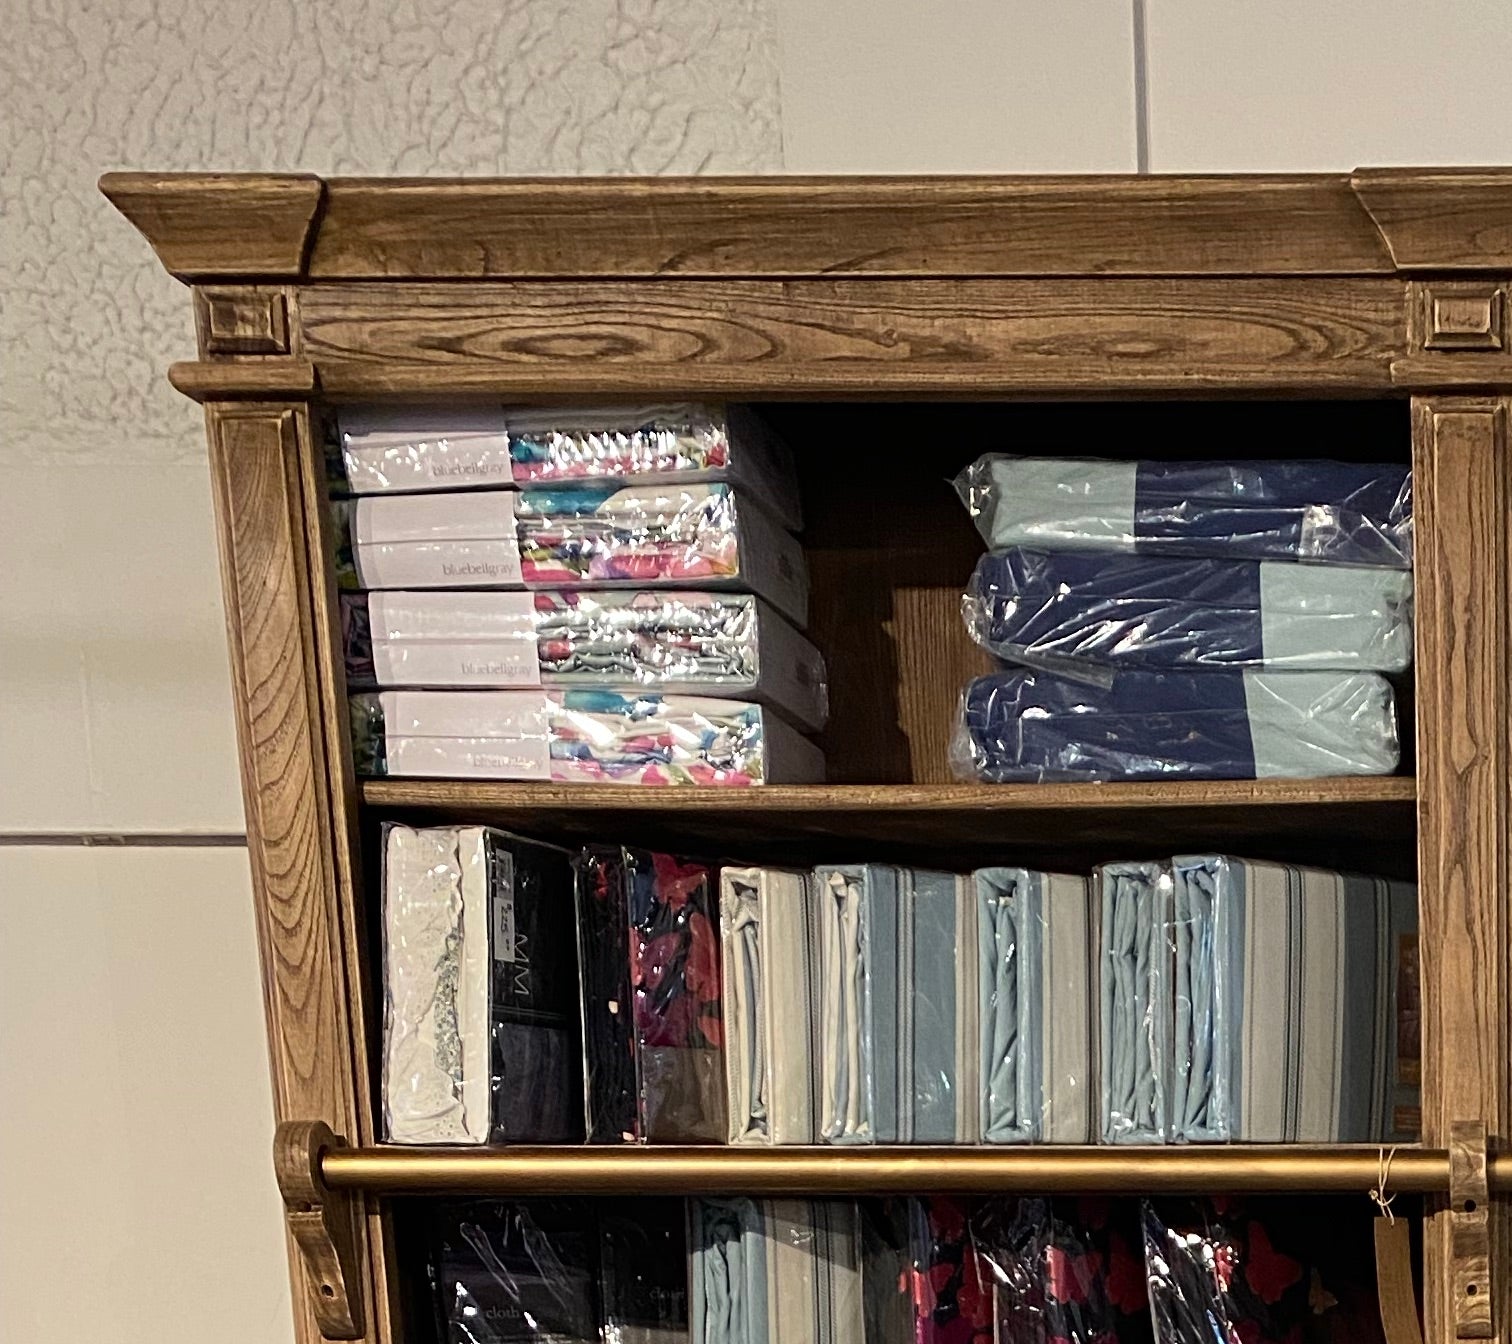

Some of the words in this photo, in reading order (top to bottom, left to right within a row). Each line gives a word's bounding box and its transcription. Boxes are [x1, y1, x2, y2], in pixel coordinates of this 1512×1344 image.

[442, 562, 514, 577] bluebellgray
[461, 662, 532, 677] bluebellgray
[486, 1305, 520, 1320] cloth
